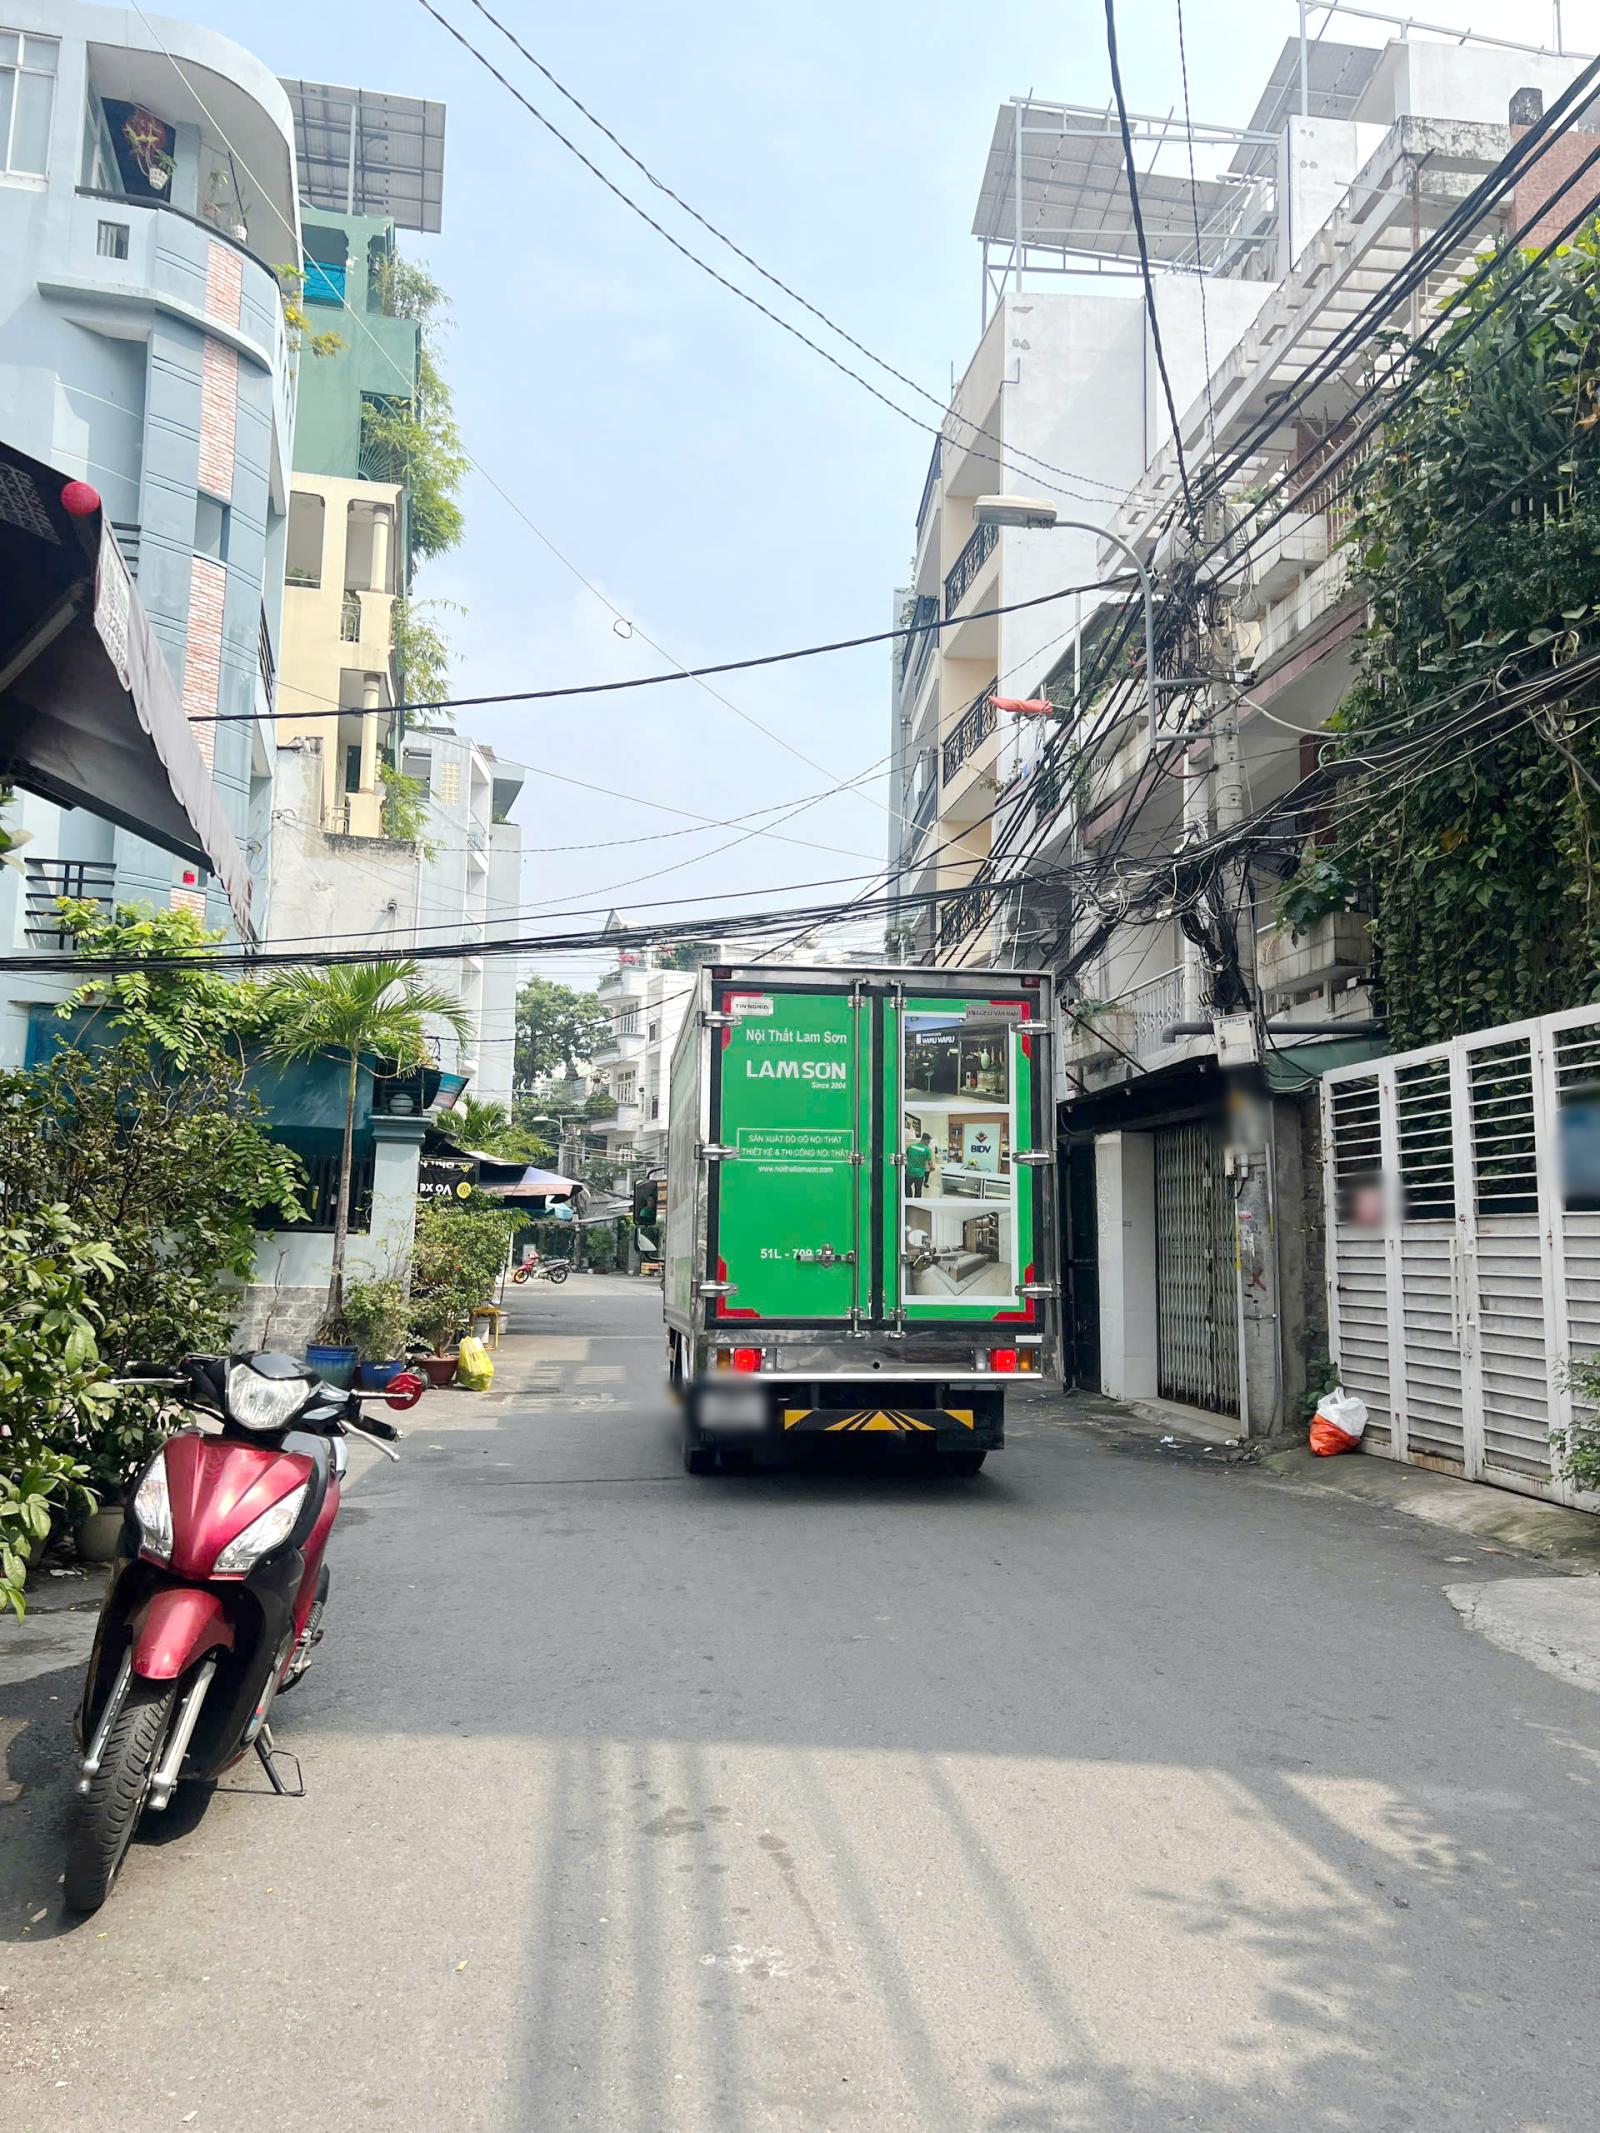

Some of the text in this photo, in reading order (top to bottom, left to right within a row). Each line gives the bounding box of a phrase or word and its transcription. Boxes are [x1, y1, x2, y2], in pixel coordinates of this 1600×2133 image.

[746, 1027, 847, 1044] Nội Thất Lam Sơn
[774, 1148, 780, 1156] &
[970, 1145, 991, 1153] BIDV
[760, 1248, 782, 1259] 51L
